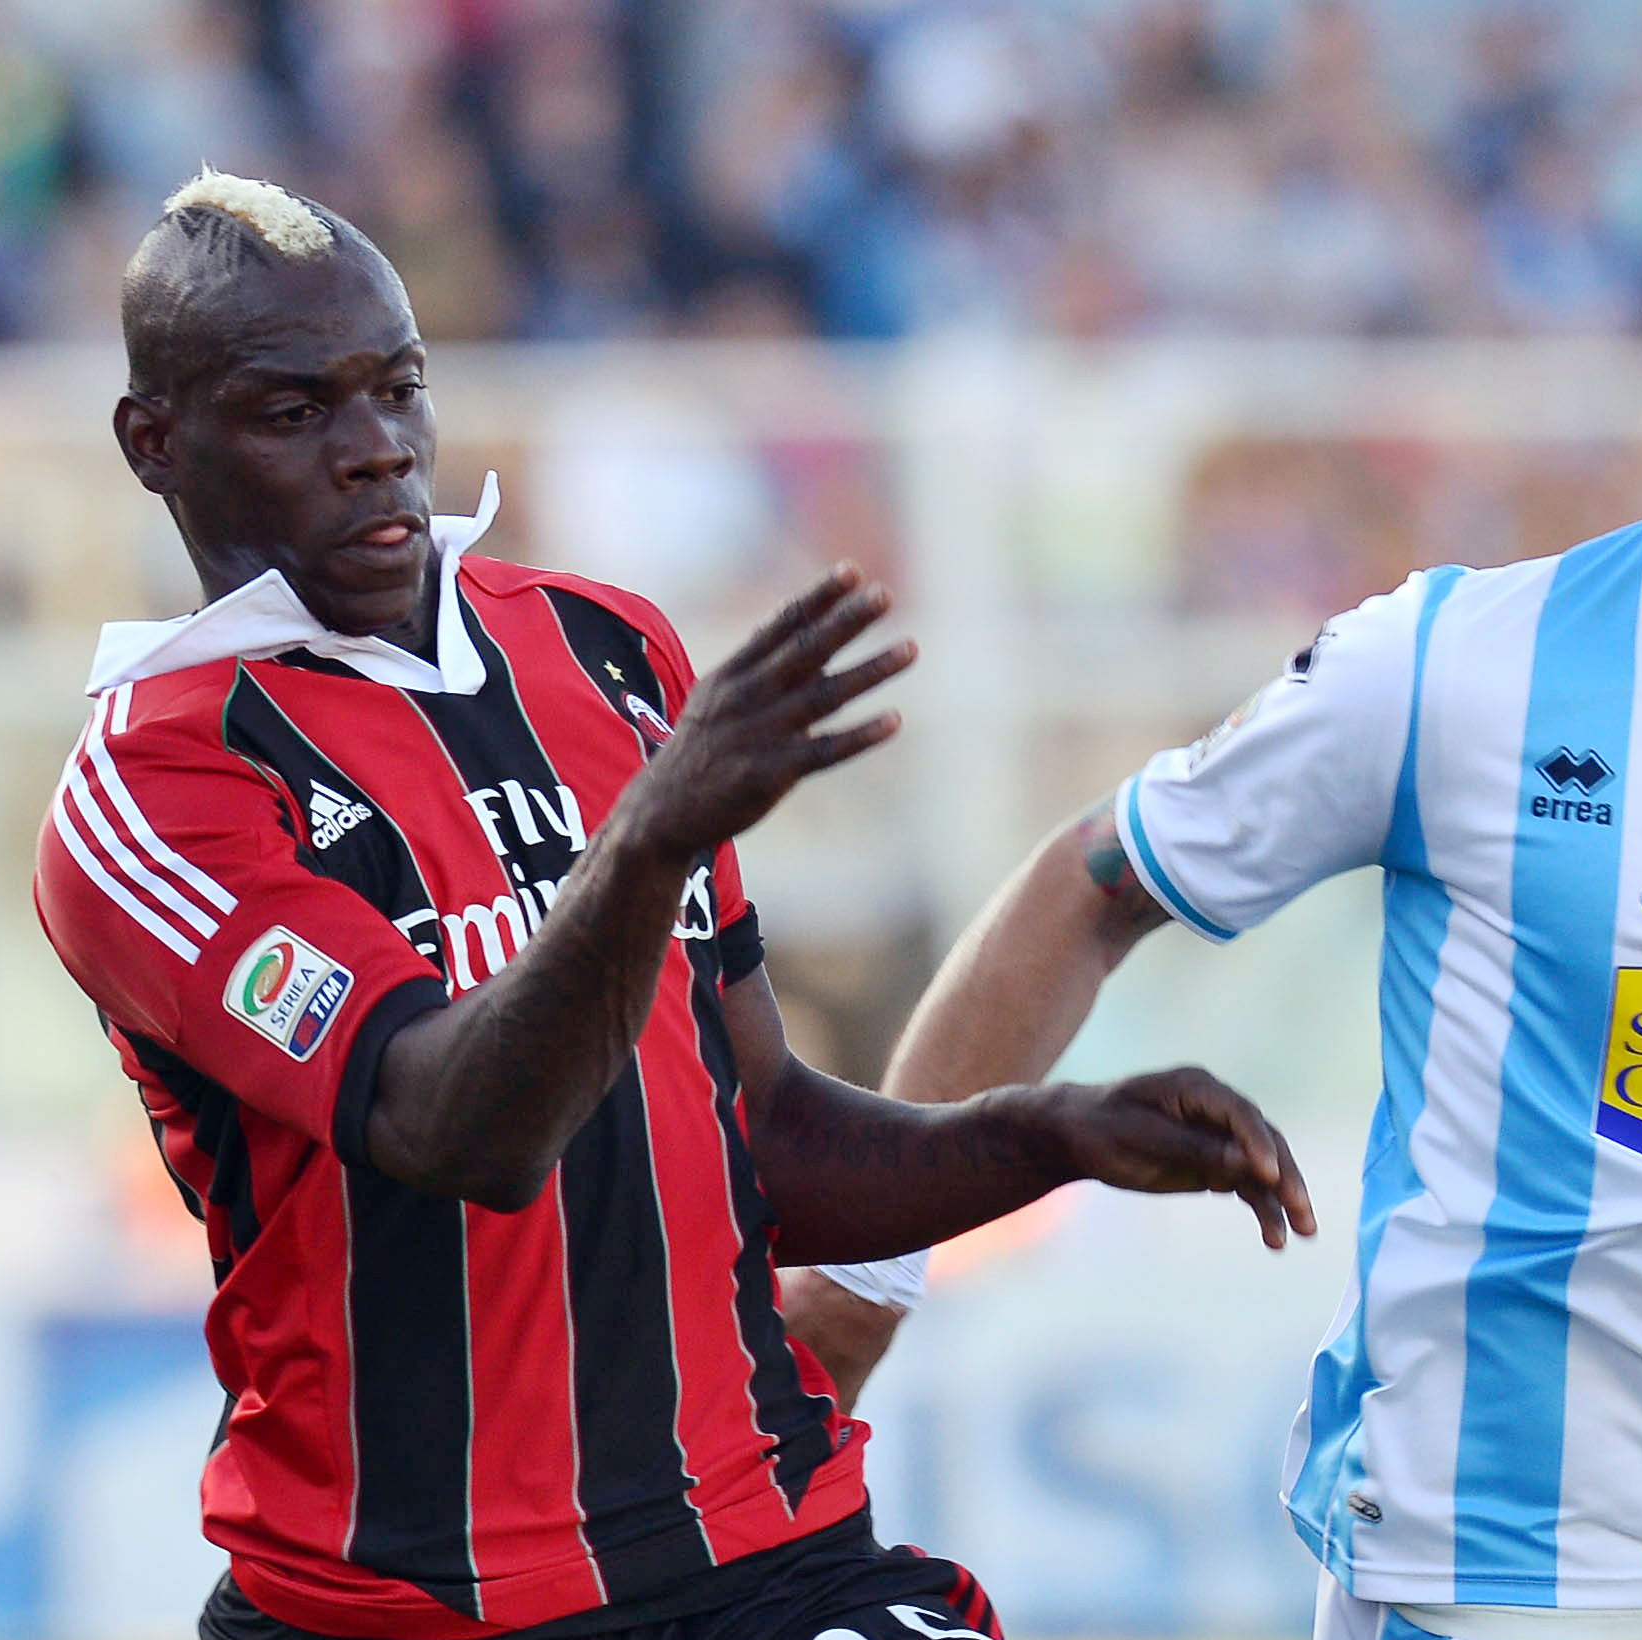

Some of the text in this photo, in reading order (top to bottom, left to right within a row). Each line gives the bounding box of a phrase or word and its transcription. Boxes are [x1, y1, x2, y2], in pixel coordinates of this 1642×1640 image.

[312, 802, 373, 850] adidas
[463, 779, 587, 856] Fly
[270, 967, 316, 1029] SERIE A
[309, 975, 343, 1020] TIM
